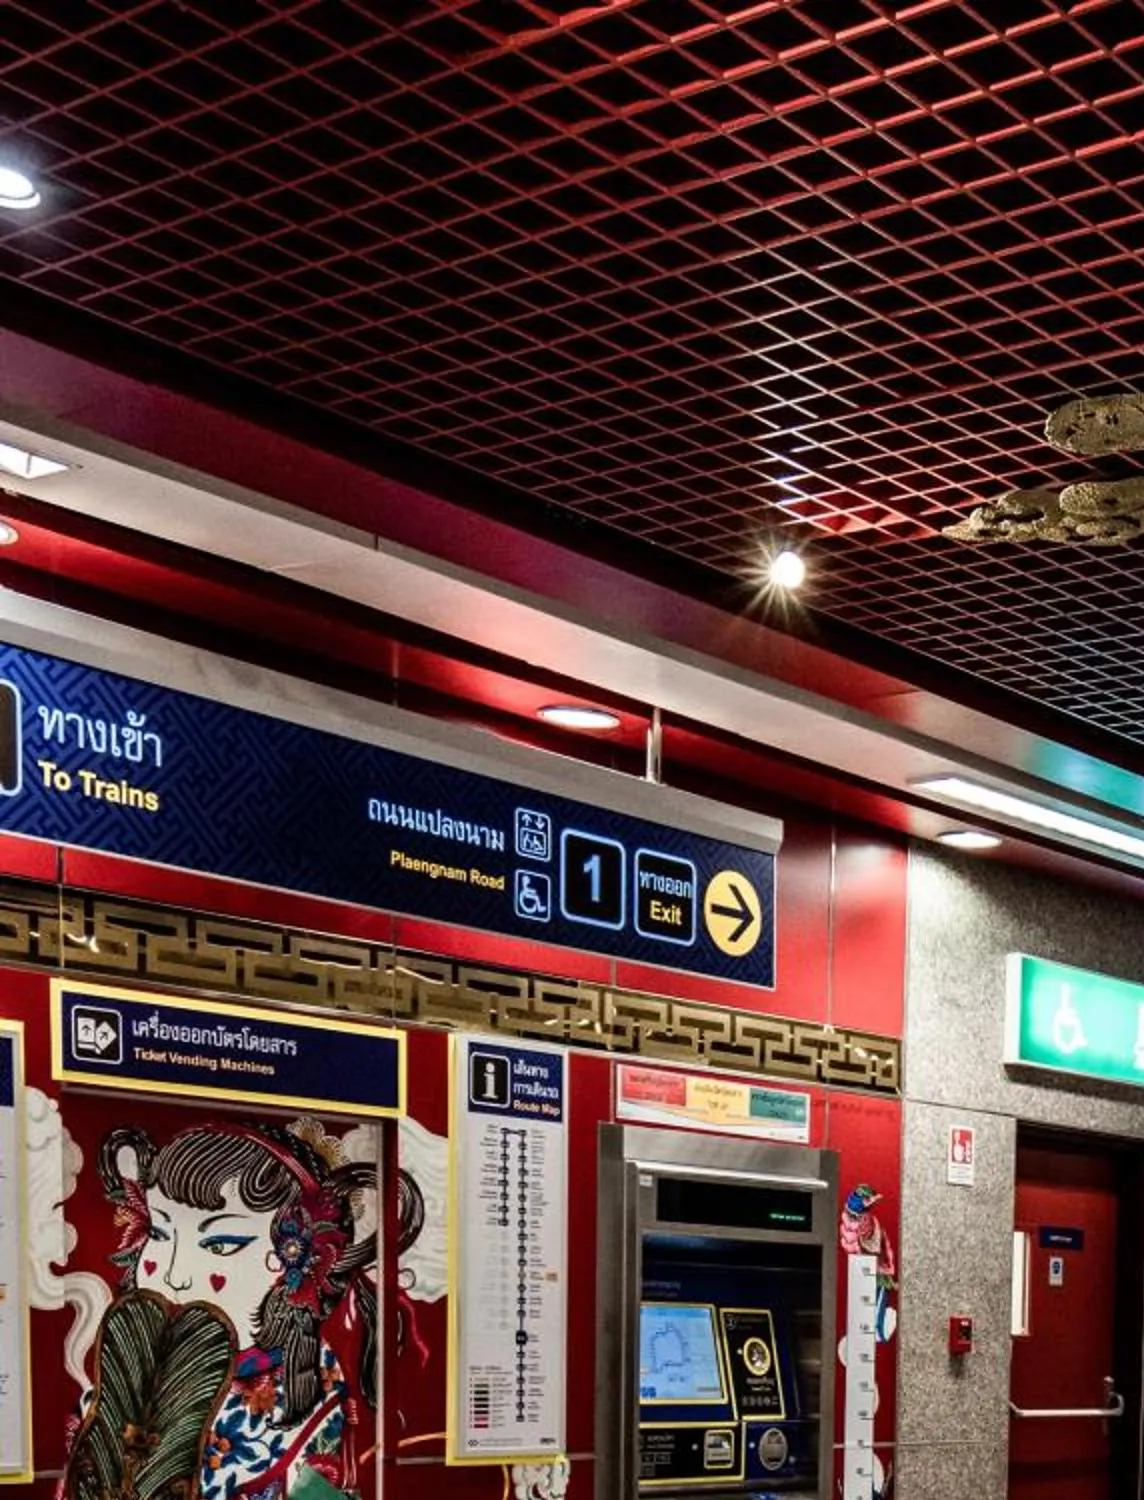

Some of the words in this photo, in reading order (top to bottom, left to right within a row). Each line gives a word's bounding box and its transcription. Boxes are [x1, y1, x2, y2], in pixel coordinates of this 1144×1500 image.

[38, 705, 161, 767] ทางเข้า
[38, 760, 71, 791] To
[78, 770, 160, 811] Trains
[368, 797, 505, 852] ถนนแปลงนาม
[390, 850, 467, 884] Plaengnam
[470, 868, 506, 891] Road
[583, 853, 600, 902] 1
[639, 869, 692, 899] ทางออก
[650, 900, 683, 926] Exit
[132, 1010, 298, 1056] เครื่องออกบัตรโดยสาร
[133, 1047, 167, 1063] Ticket
[169, 1053, 218, 1071] Vending
[221, 1057, 275, 1075] Machines
